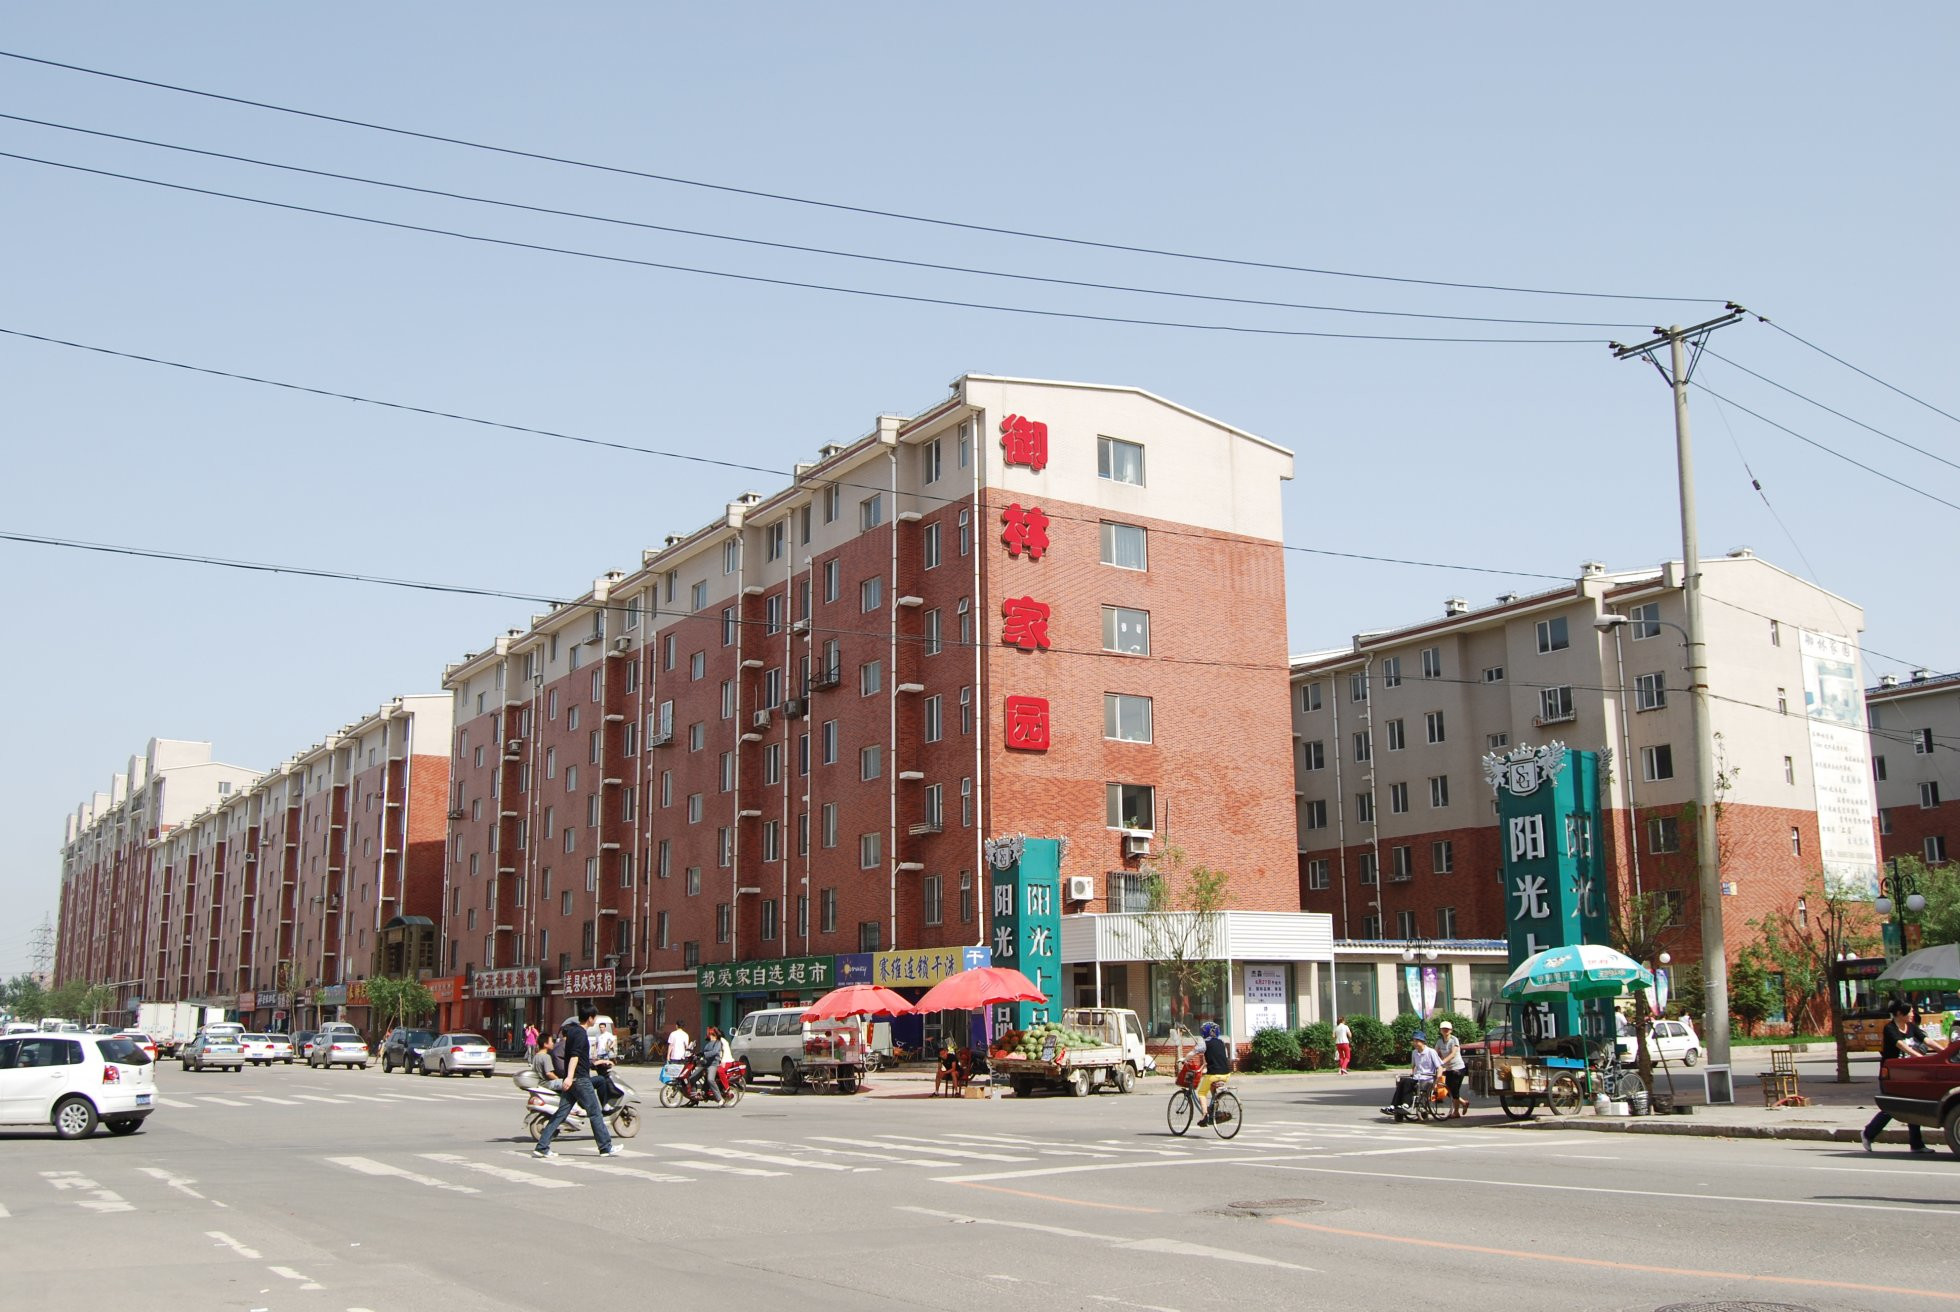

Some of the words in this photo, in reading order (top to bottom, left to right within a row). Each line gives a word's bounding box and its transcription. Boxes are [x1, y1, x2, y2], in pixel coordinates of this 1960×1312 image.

[999, 413, 1050, 751] 御林家园
[701, 962, 827, 988] 都爱家自选超市
[879, 954, 955, 982] 赛维连锁干洗
[994, 884, 1013, 1040] 阳光品
